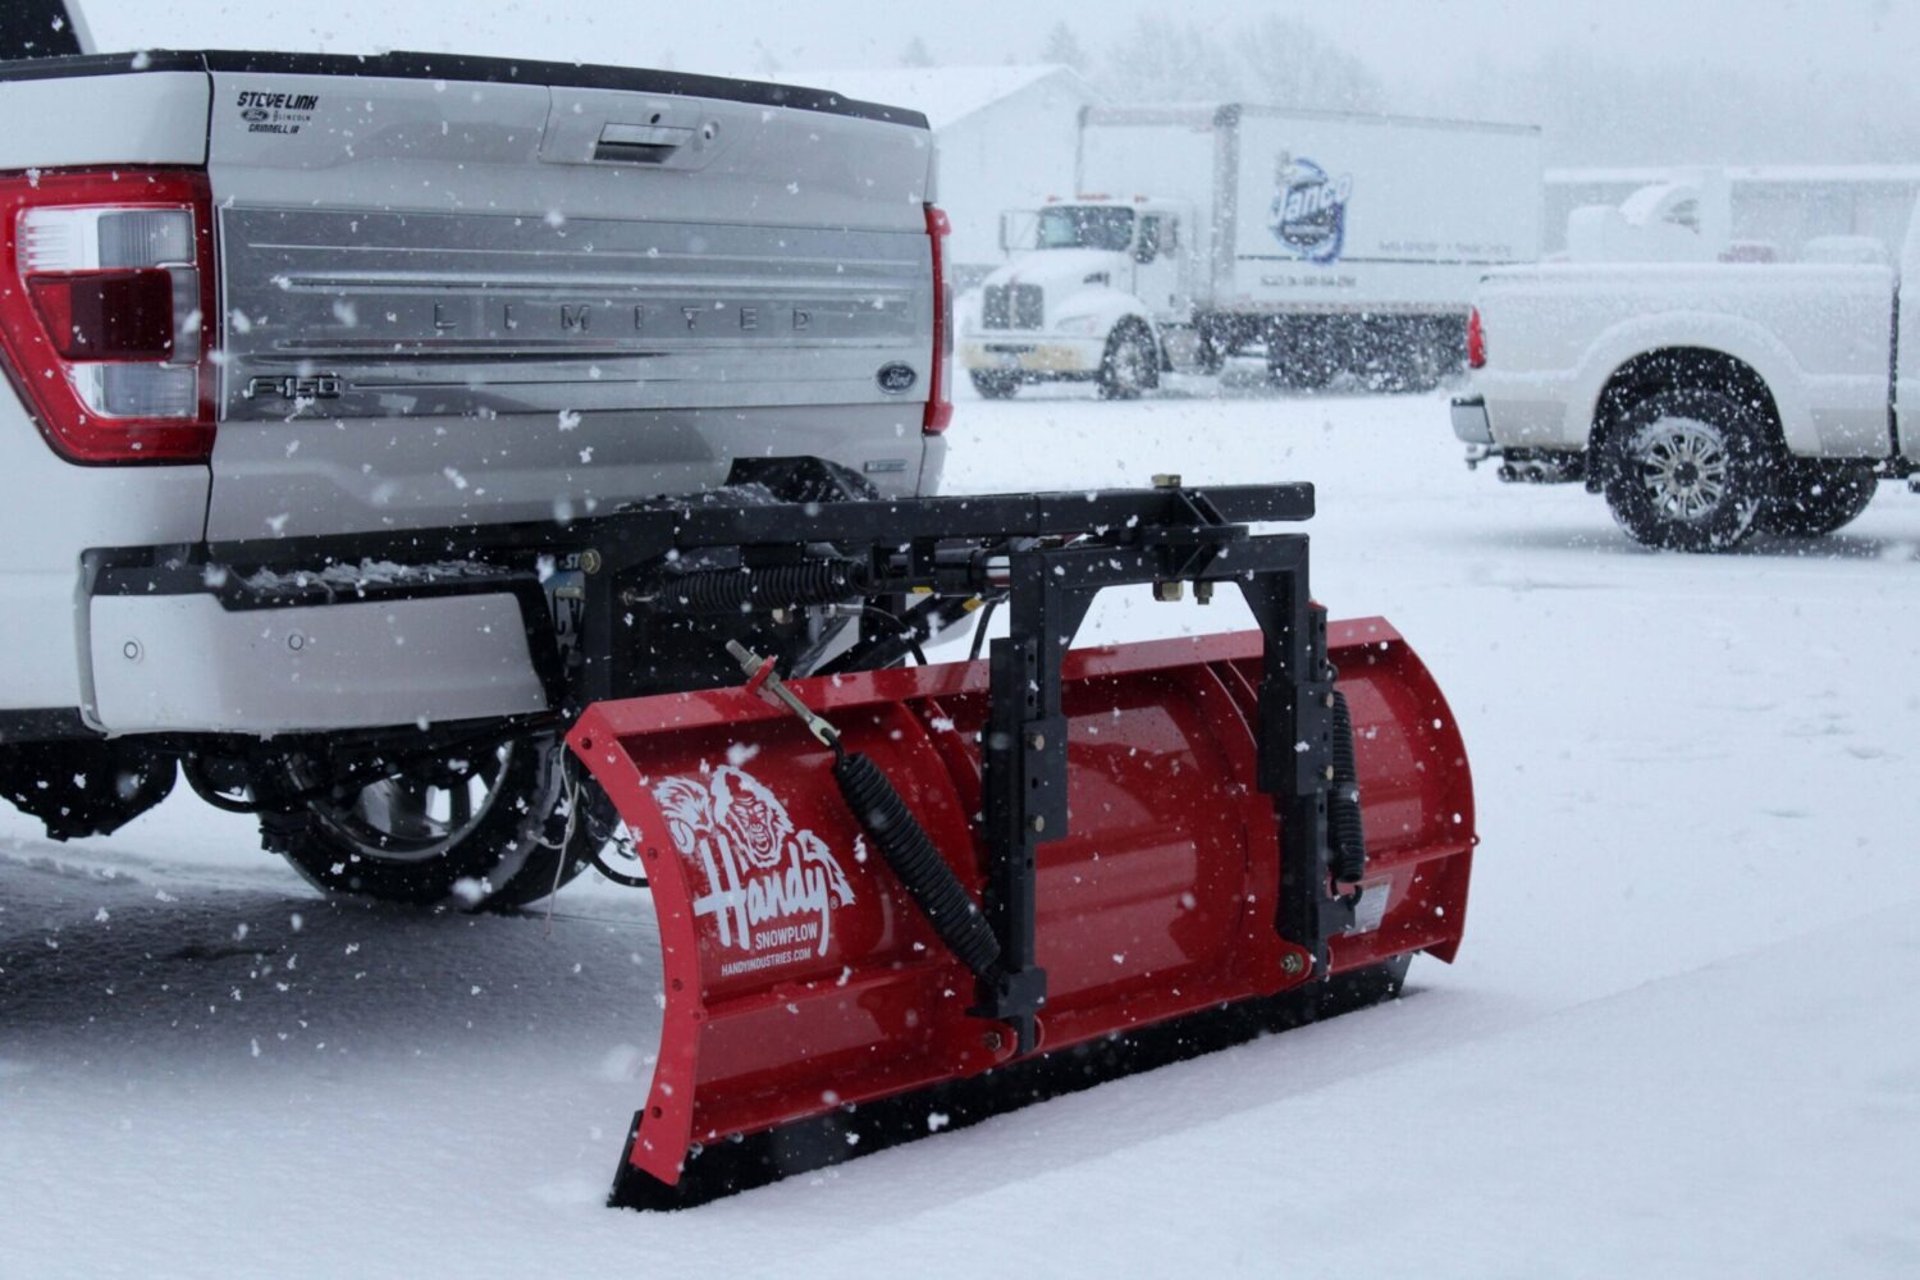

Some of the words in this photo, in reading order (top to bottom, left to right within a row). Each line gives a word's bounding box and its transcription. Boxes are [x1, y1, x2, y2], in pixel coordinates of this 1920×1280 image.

[237, 91, 285, 108] STEVE
[285, 94, 318, 110] LINK
[434, 302, 812, 332] LIMITED
[693, 834, 830, 957] Handy
[755, 922, 818, 950] SNOWPLOW
[721, 947, 812, 976] HANDYINDUSTRIES.COM
